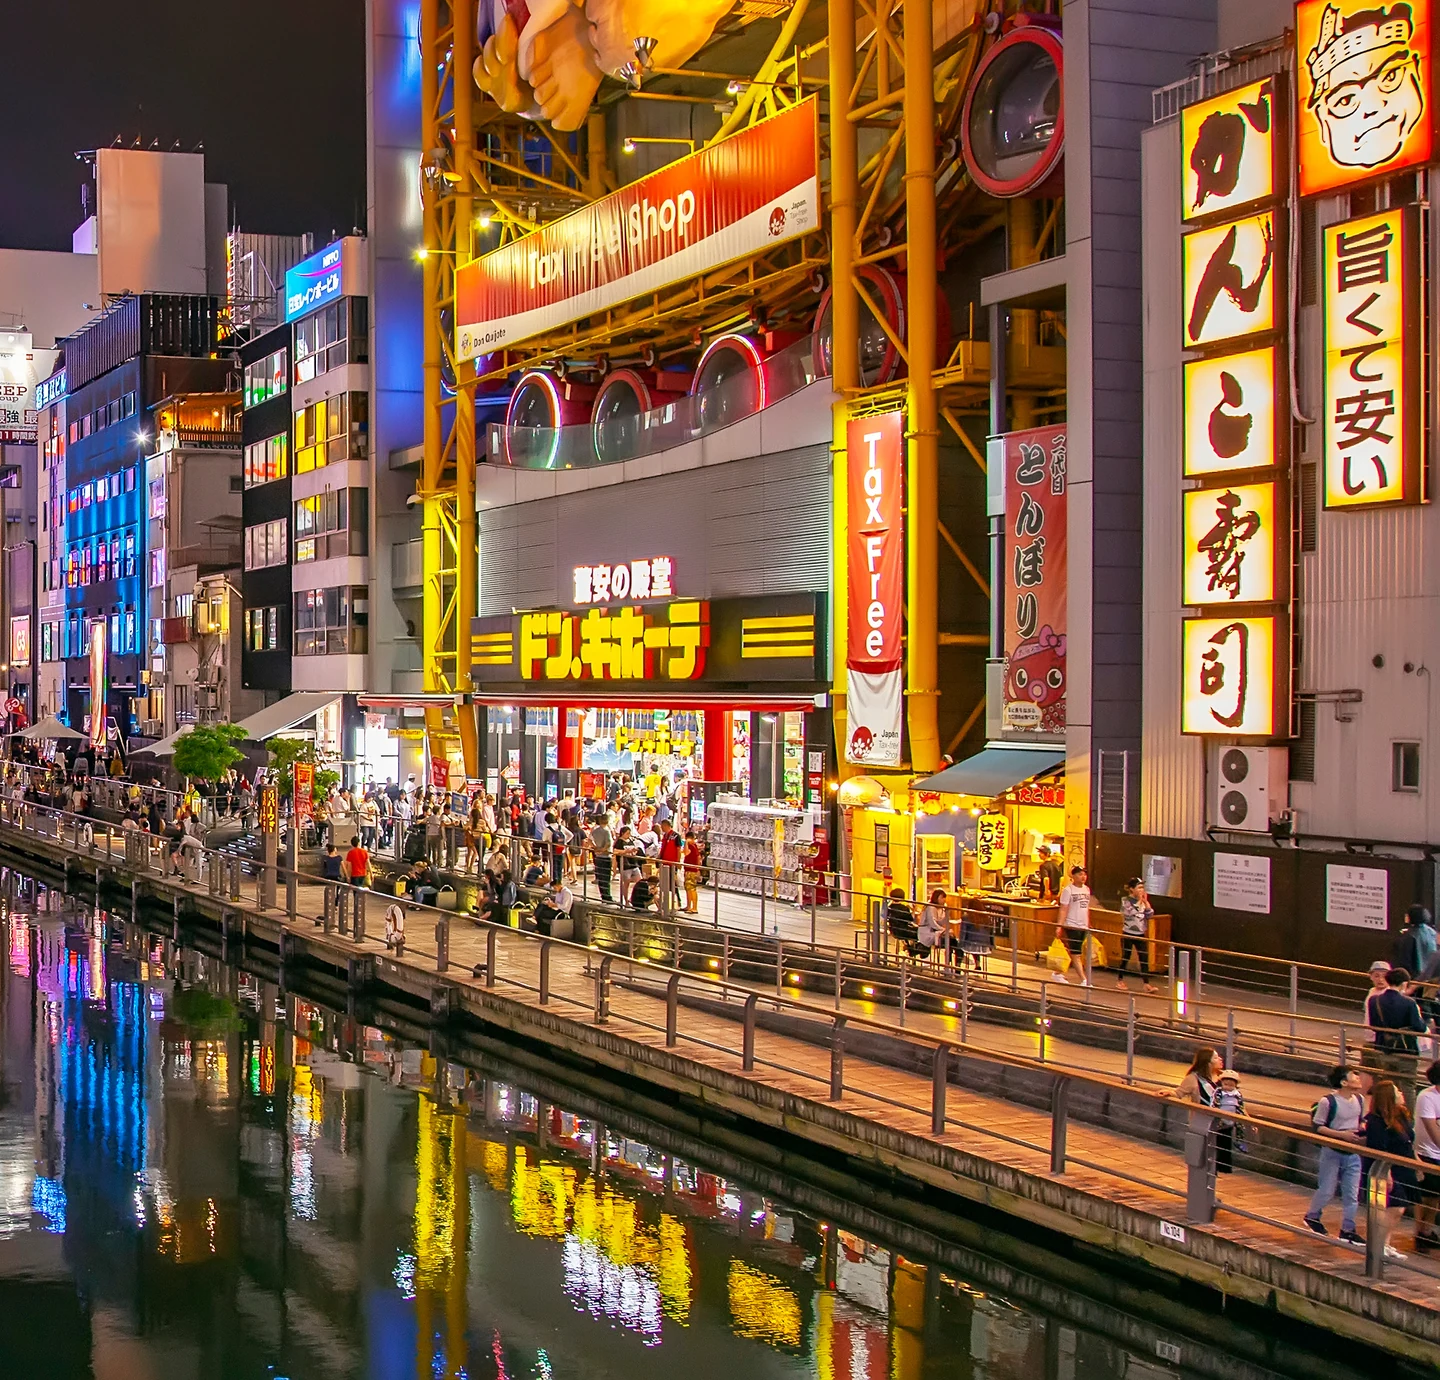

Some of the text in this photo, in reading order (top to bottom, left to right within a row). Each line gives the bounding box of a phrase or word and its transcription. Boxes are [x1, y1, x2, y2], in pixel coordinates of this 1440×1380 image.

[528, 248, 564, 289] Tax
[629, 189, 695, 246] Shop
[473, 328, 506, 348] Don Quijote
[1335, 222, 1395, 496] 旨くて安い
[1049, 434, 1067, 496] 二代目
[863, 431, 885, 658] Tax Free
[1015, 443, 1047, 640] とんぼり
[574, 557, 673, 604] 激安の殿堂
[979, 820, 994, 865] とんぼり
[992, 820, 1006, 851] たこ焼
